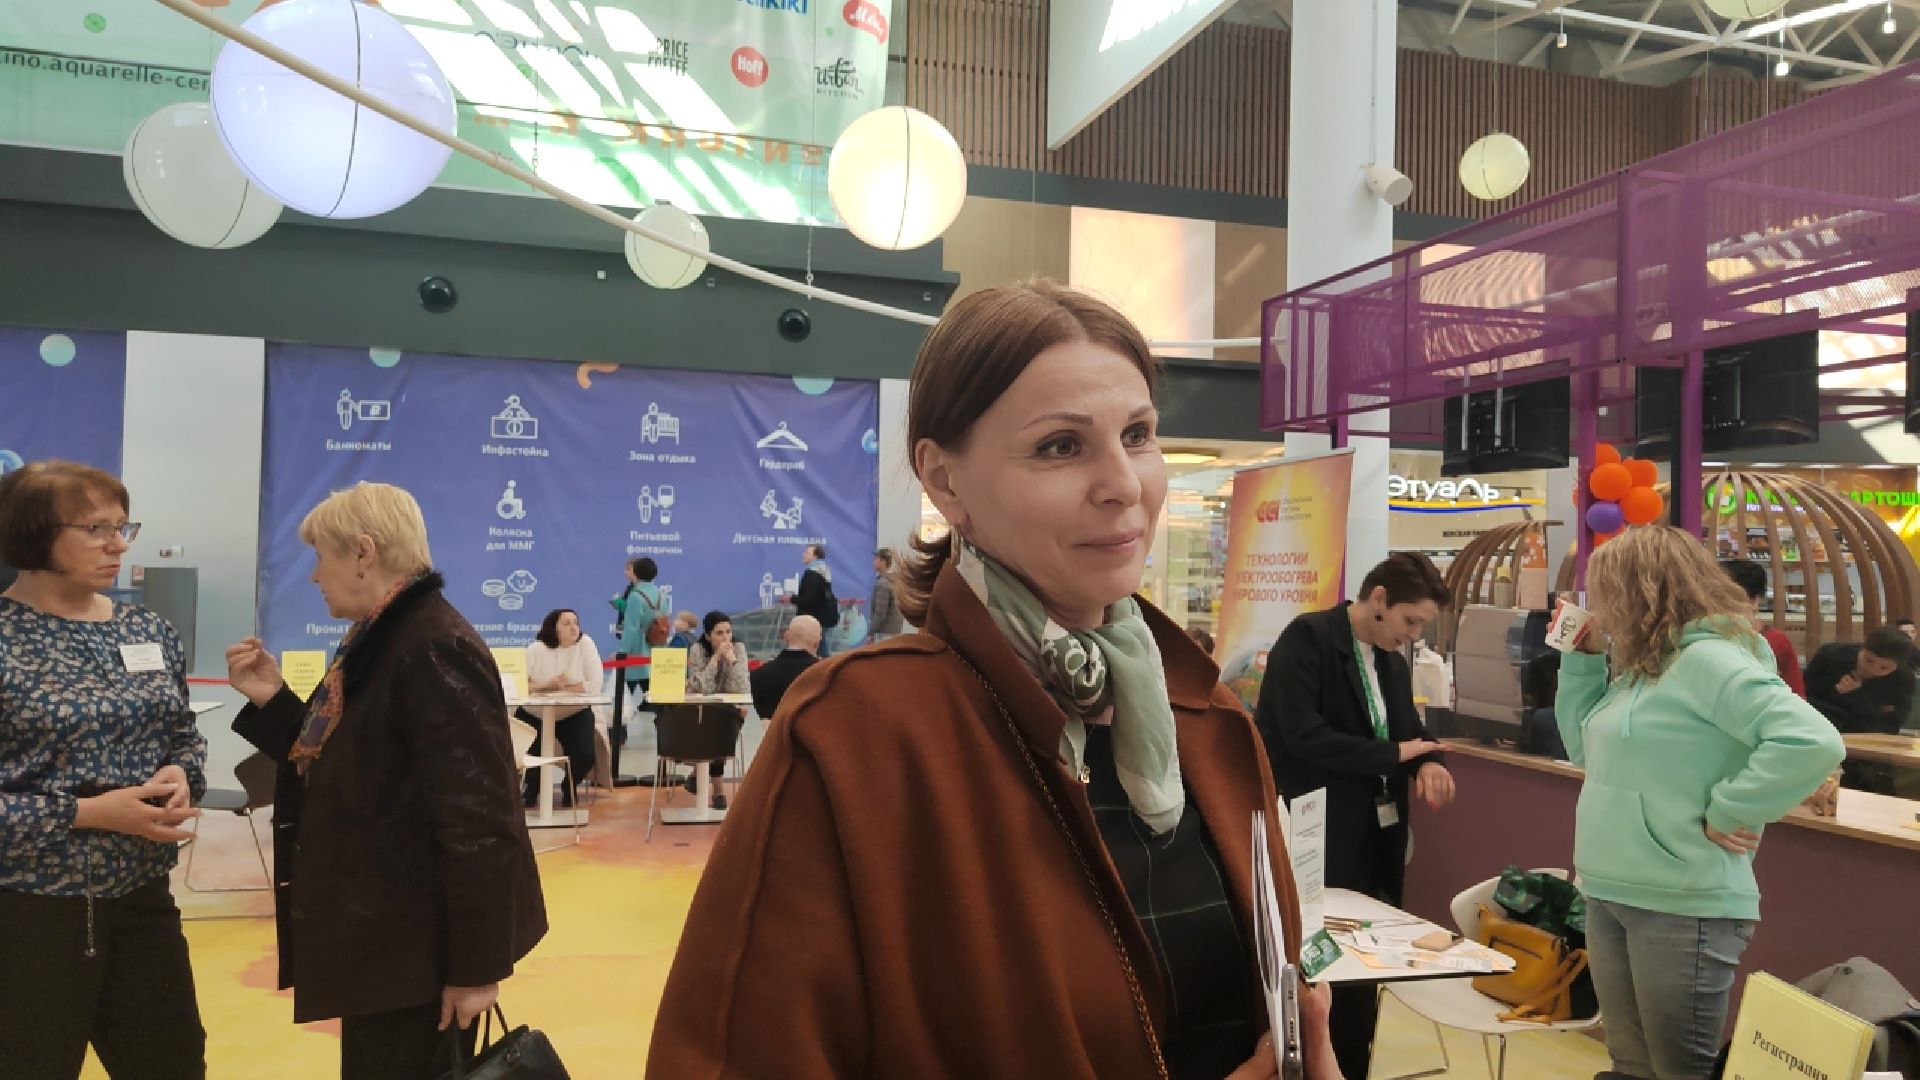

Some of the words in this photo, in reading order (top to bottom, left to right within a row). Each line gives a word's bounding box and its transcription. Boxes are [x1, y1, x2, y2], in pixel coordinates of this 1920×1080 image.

[737, 55, 764, 77] Hoff
[325, 438, 392, 451] Банкоматы
[481, 444, 550, 457] Инфостойка
[628, 451, 655, 462] Зона
[657, 454, 697, 464] отдыха
[759, 458, 805, 471] Гардероб
[488, 525, 533, 537] Коляска
[630, 530, 680, 541] Питьевой
[733, 532, 775, 545] Детская
[777, 534, 827, 545] площадка
[485, 541, 505, 551] для
[1246, 552, 1308, 566] ТЕХНОЛОГИИ
